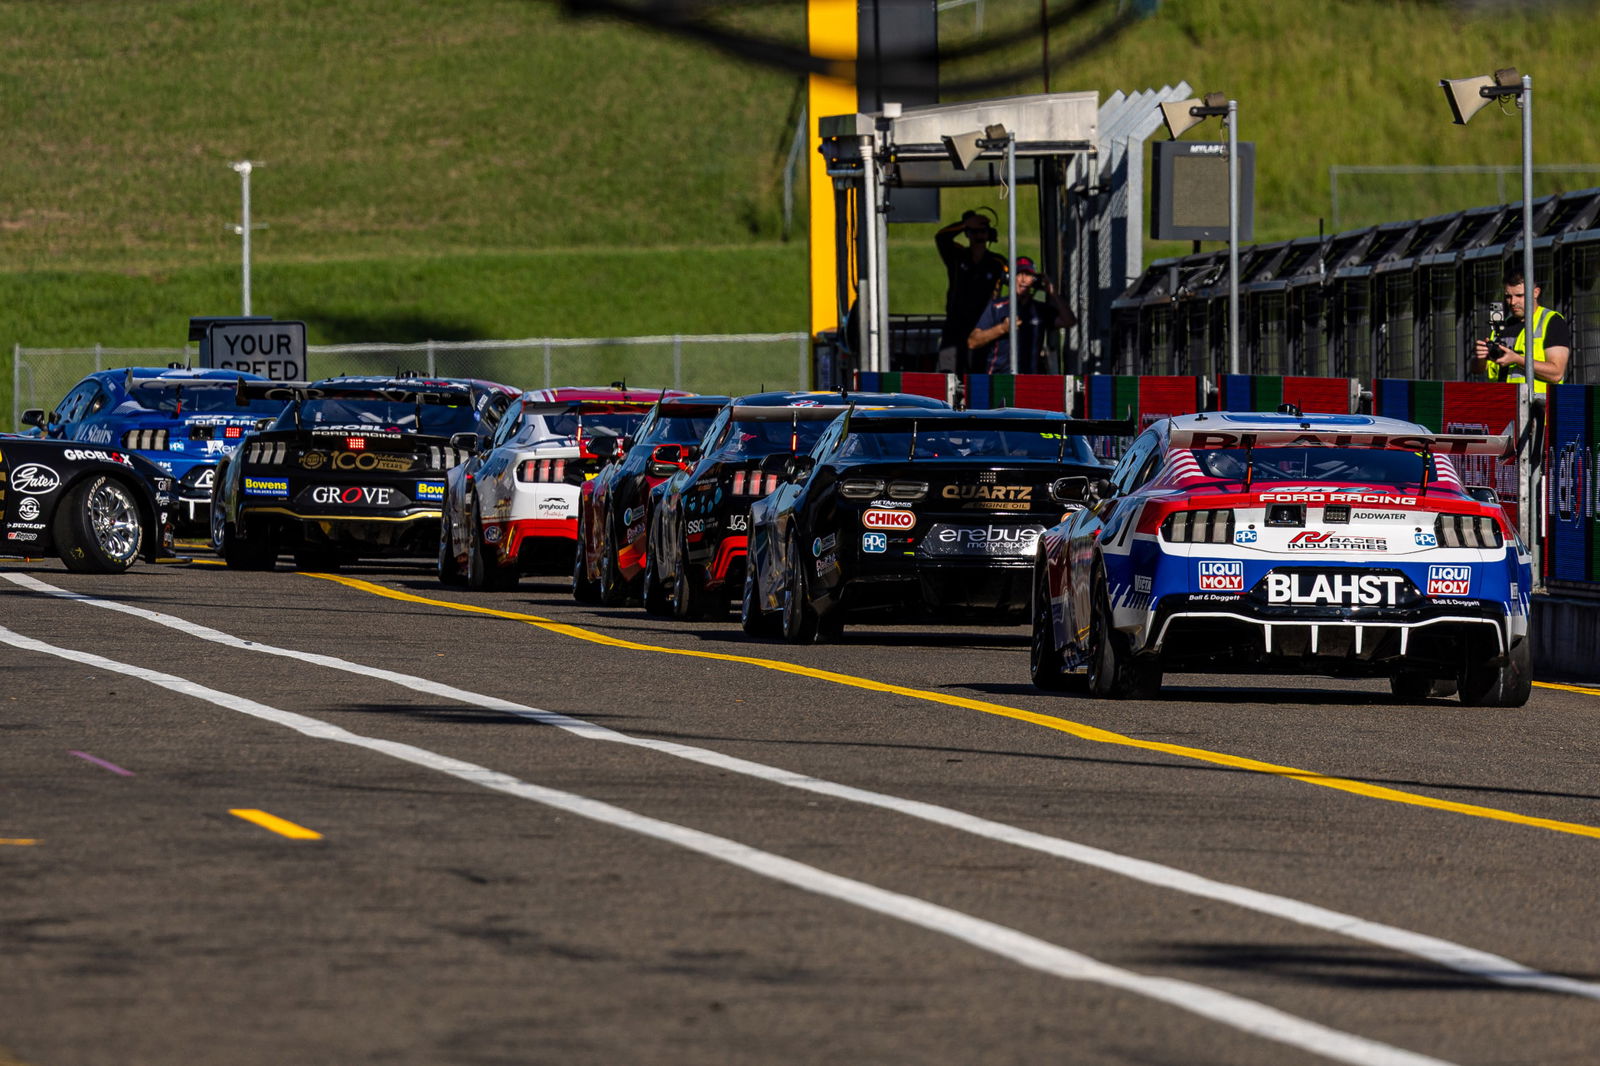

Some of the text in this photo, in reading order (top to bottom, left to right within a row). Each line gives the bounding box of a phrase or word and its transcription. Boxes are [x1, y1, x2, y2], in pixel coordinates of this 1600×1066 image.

[223, 334, 292, 356] YOUR
[221, 360, 299, 381] SPEED
[351, 431, 401, 439] RACING
[14, 467, 58, 490] Gates
[245, 478, 288, 490] Bowens
[417, 483, 445, 494] Bow
[942, 484, 1033, 500] QUARTZ
[312, 486, 391, 505] GROVE
[1259, 493, 1417, 506] FORD RACING
[19, 504, 40, 514] ACL
[538, 503, 570, 511] greyhound
[973, 502, 1009, 510] ENGINE
[866, 512, 912, 527] CHIKO
[1352, 512, 1407, 521] ADDWATER
[12, 522, 47, 531] DUNLOP
[687, 518, 705, 535] SSG
[939, 524, 1039, 542] erebus
[15, 531, 38, 541] Repco
[1236, 531, 1257, 542] PPG
[1330, 537, 1387, 546] RACER
[1415, 533, 1436, 546] PPG
[864, 535, 885, 551] PPG
[1287, 542, 1388, 551] INDUSTRIES
[1201, 563, 1241, 576] LIQUI
[1431, 567, 1468, 581] LIQUI
[1201, 576, 1242, 589] MOLY
[1267, 572, 1405, 606] BLAHST
[1430, 580, 1469, 594] MOLY
[1210, 594, 1241, 603] Doggett
[1453, 599, 1480, 607] Doggett
